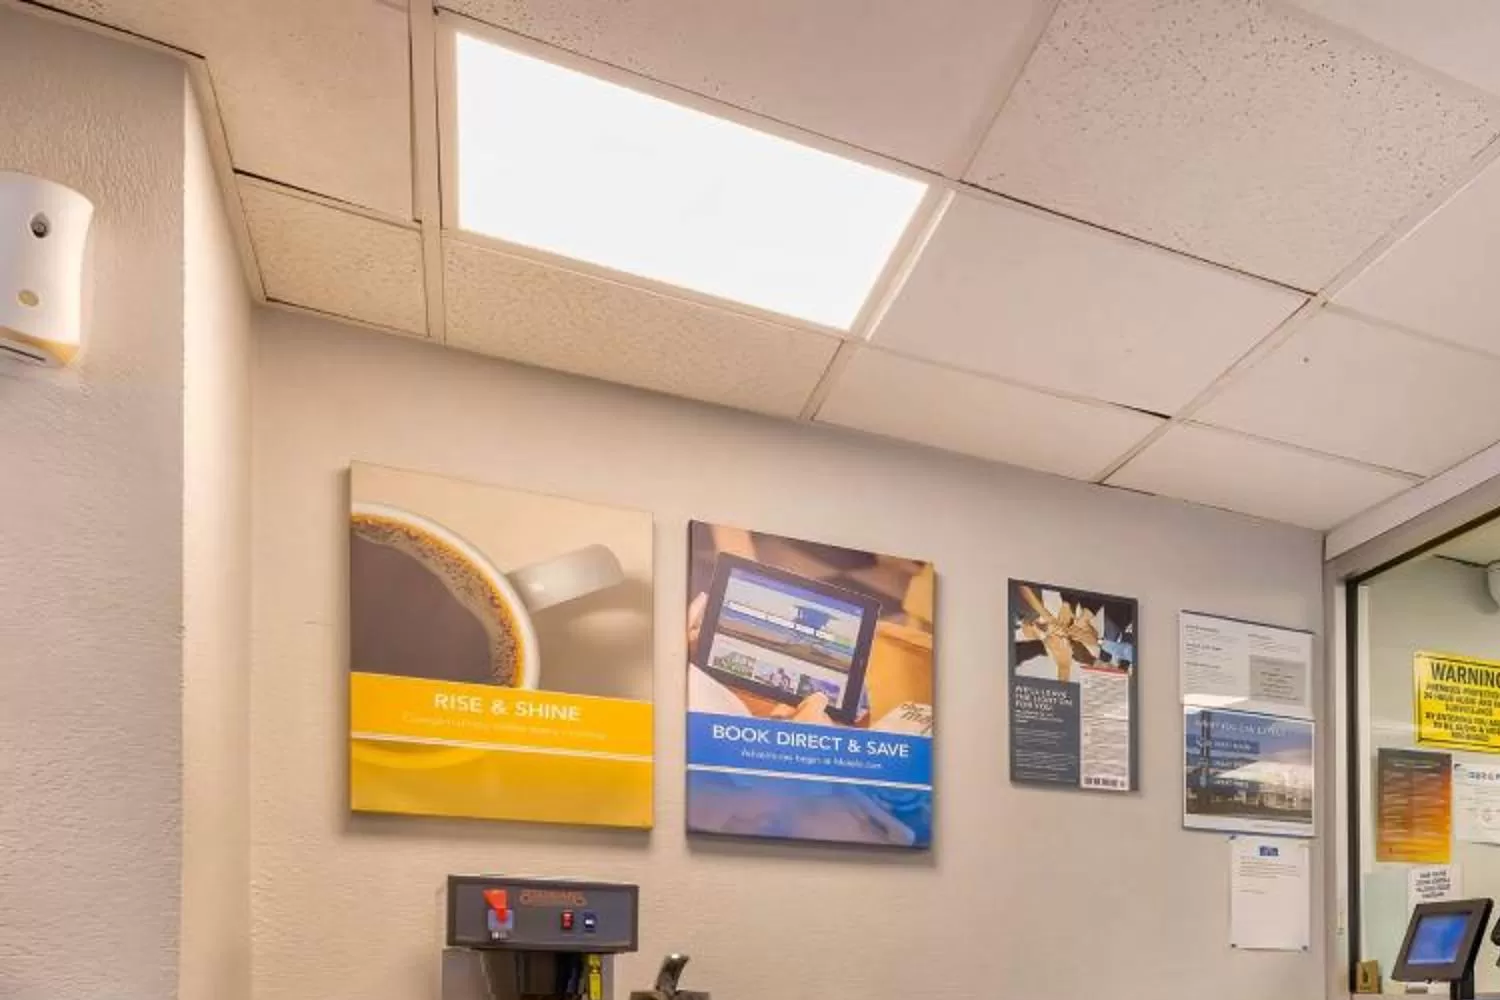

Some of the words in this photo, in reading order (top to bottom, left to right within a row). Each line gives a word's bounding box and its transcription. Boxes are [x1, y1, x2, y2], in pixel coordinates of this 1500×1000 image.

[434, 693, 484, 714] RISE
[490, 699, 508, 716] &
[514, 700, 582, 722] SHINE
[712, 724, 770, 745] BOOK
[777, 731, 843, 752] DIRECT
[847, 739, 861, 754] &
[866, 741, 910, 758] SAVE
